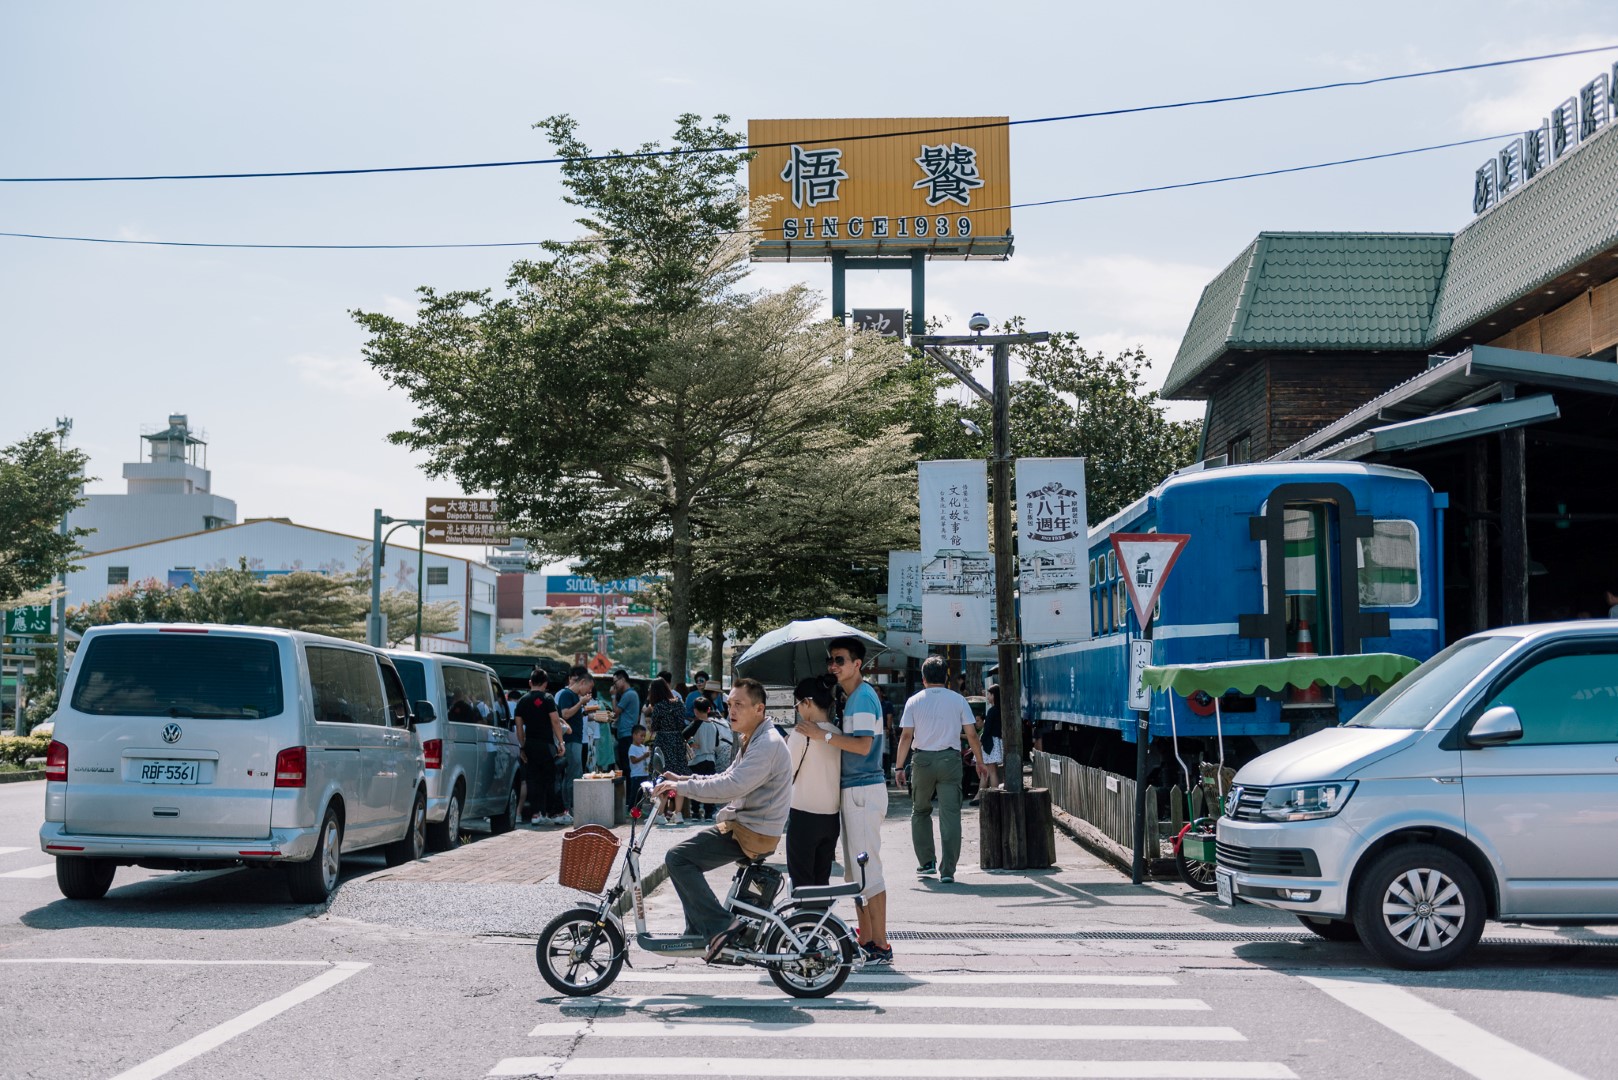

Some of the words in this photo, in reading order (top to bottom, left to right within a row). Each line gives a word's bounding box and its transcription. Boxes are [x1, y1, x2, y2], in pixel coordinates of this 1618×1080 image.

[447, 499, 503, 513] 大坡池風景
[949, 484, 961, 546] 文化故事館
[1036, 517, 1071, 532] 週年
[141, 765, 195, 780] RBF-5361
